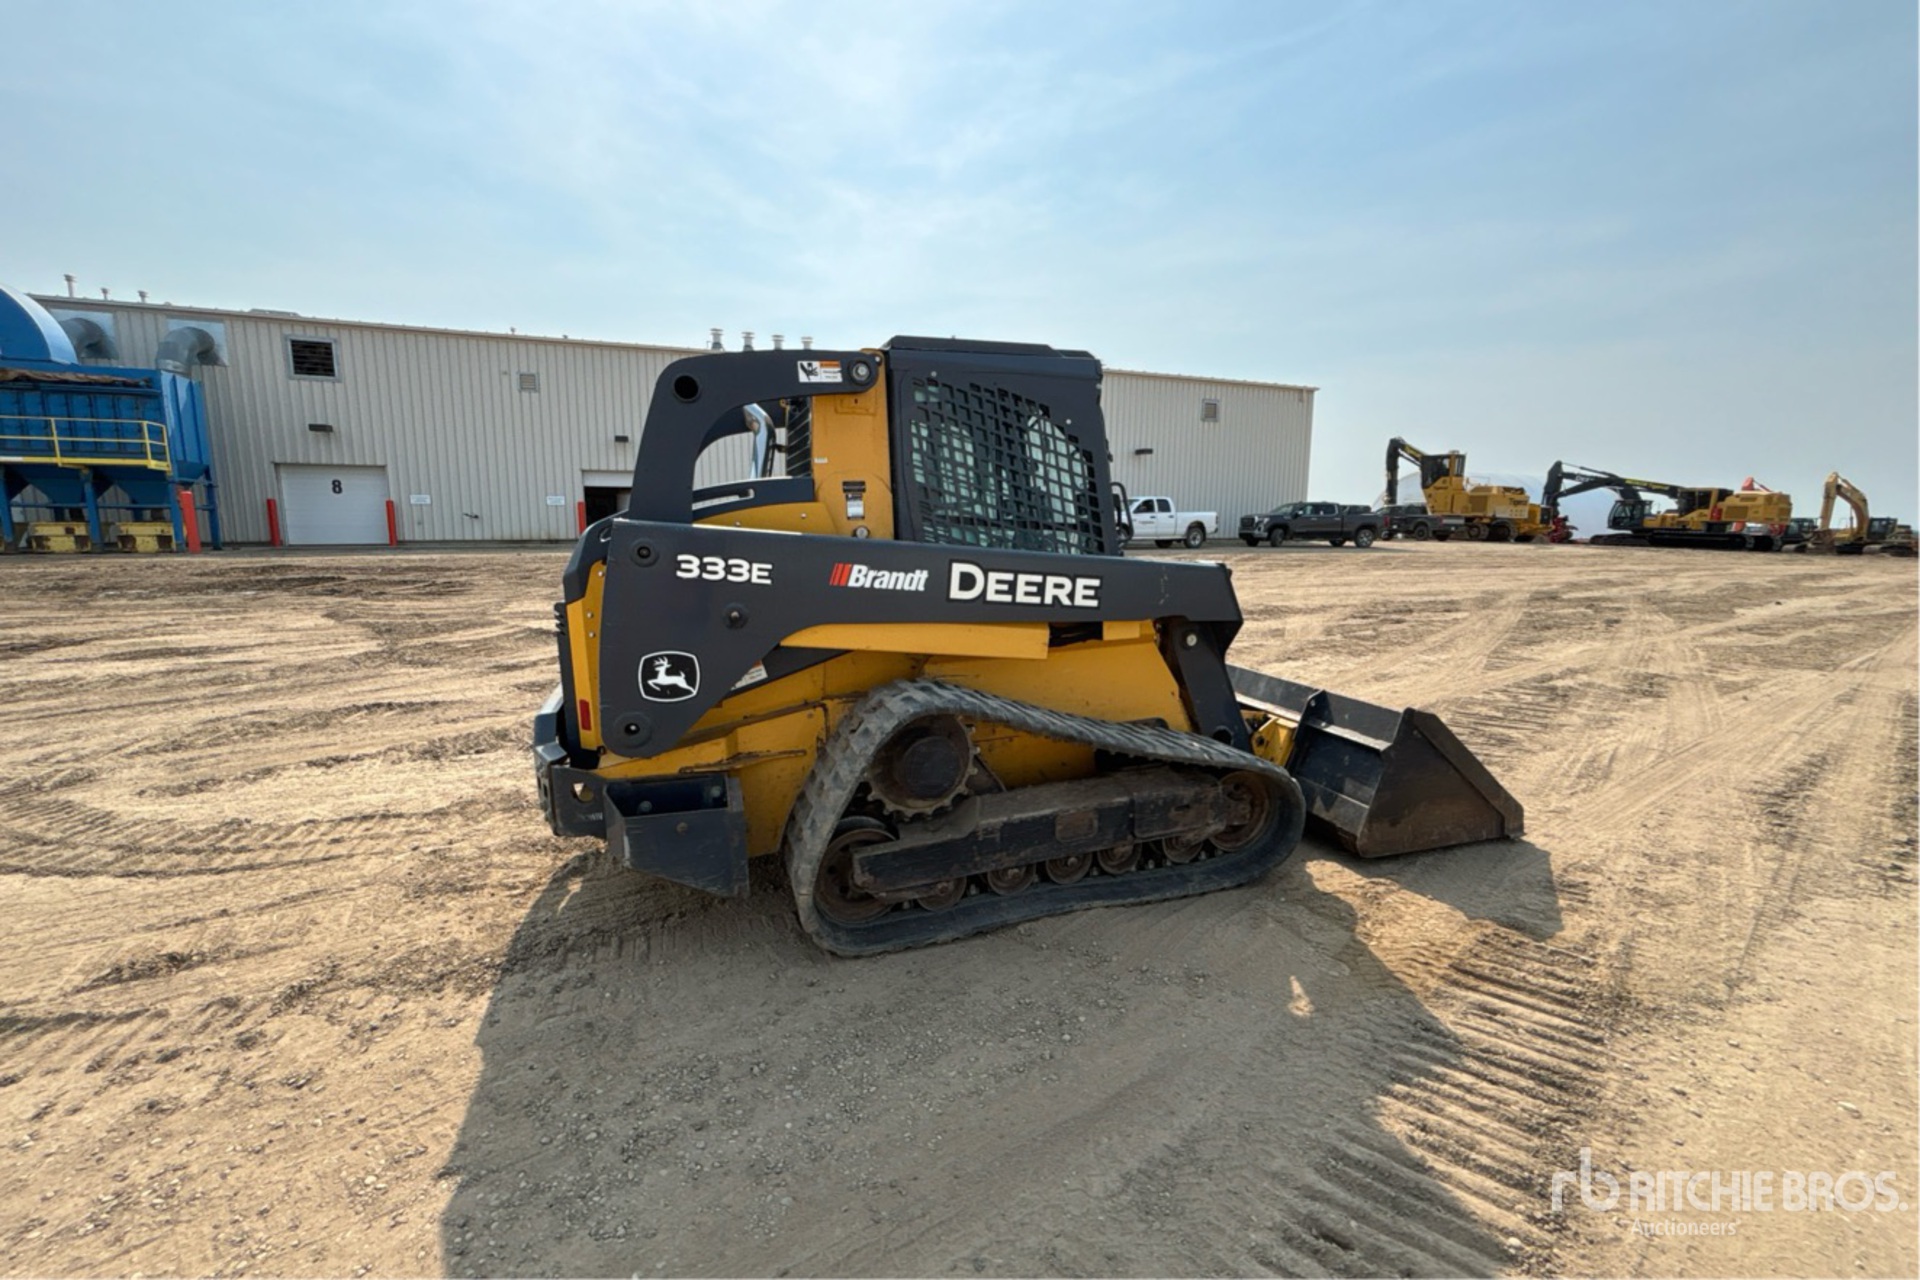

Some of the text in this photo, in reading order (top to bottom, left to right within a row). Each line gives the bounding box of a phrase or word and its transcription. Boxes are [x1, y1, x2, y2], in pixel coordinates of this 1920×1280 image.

[331, 479, 343, 495] 8
[675, 553, 773, 585] 333E
[847, 563, 930, 593] Brandt
[948, 561, 1101, 608] DEERE
